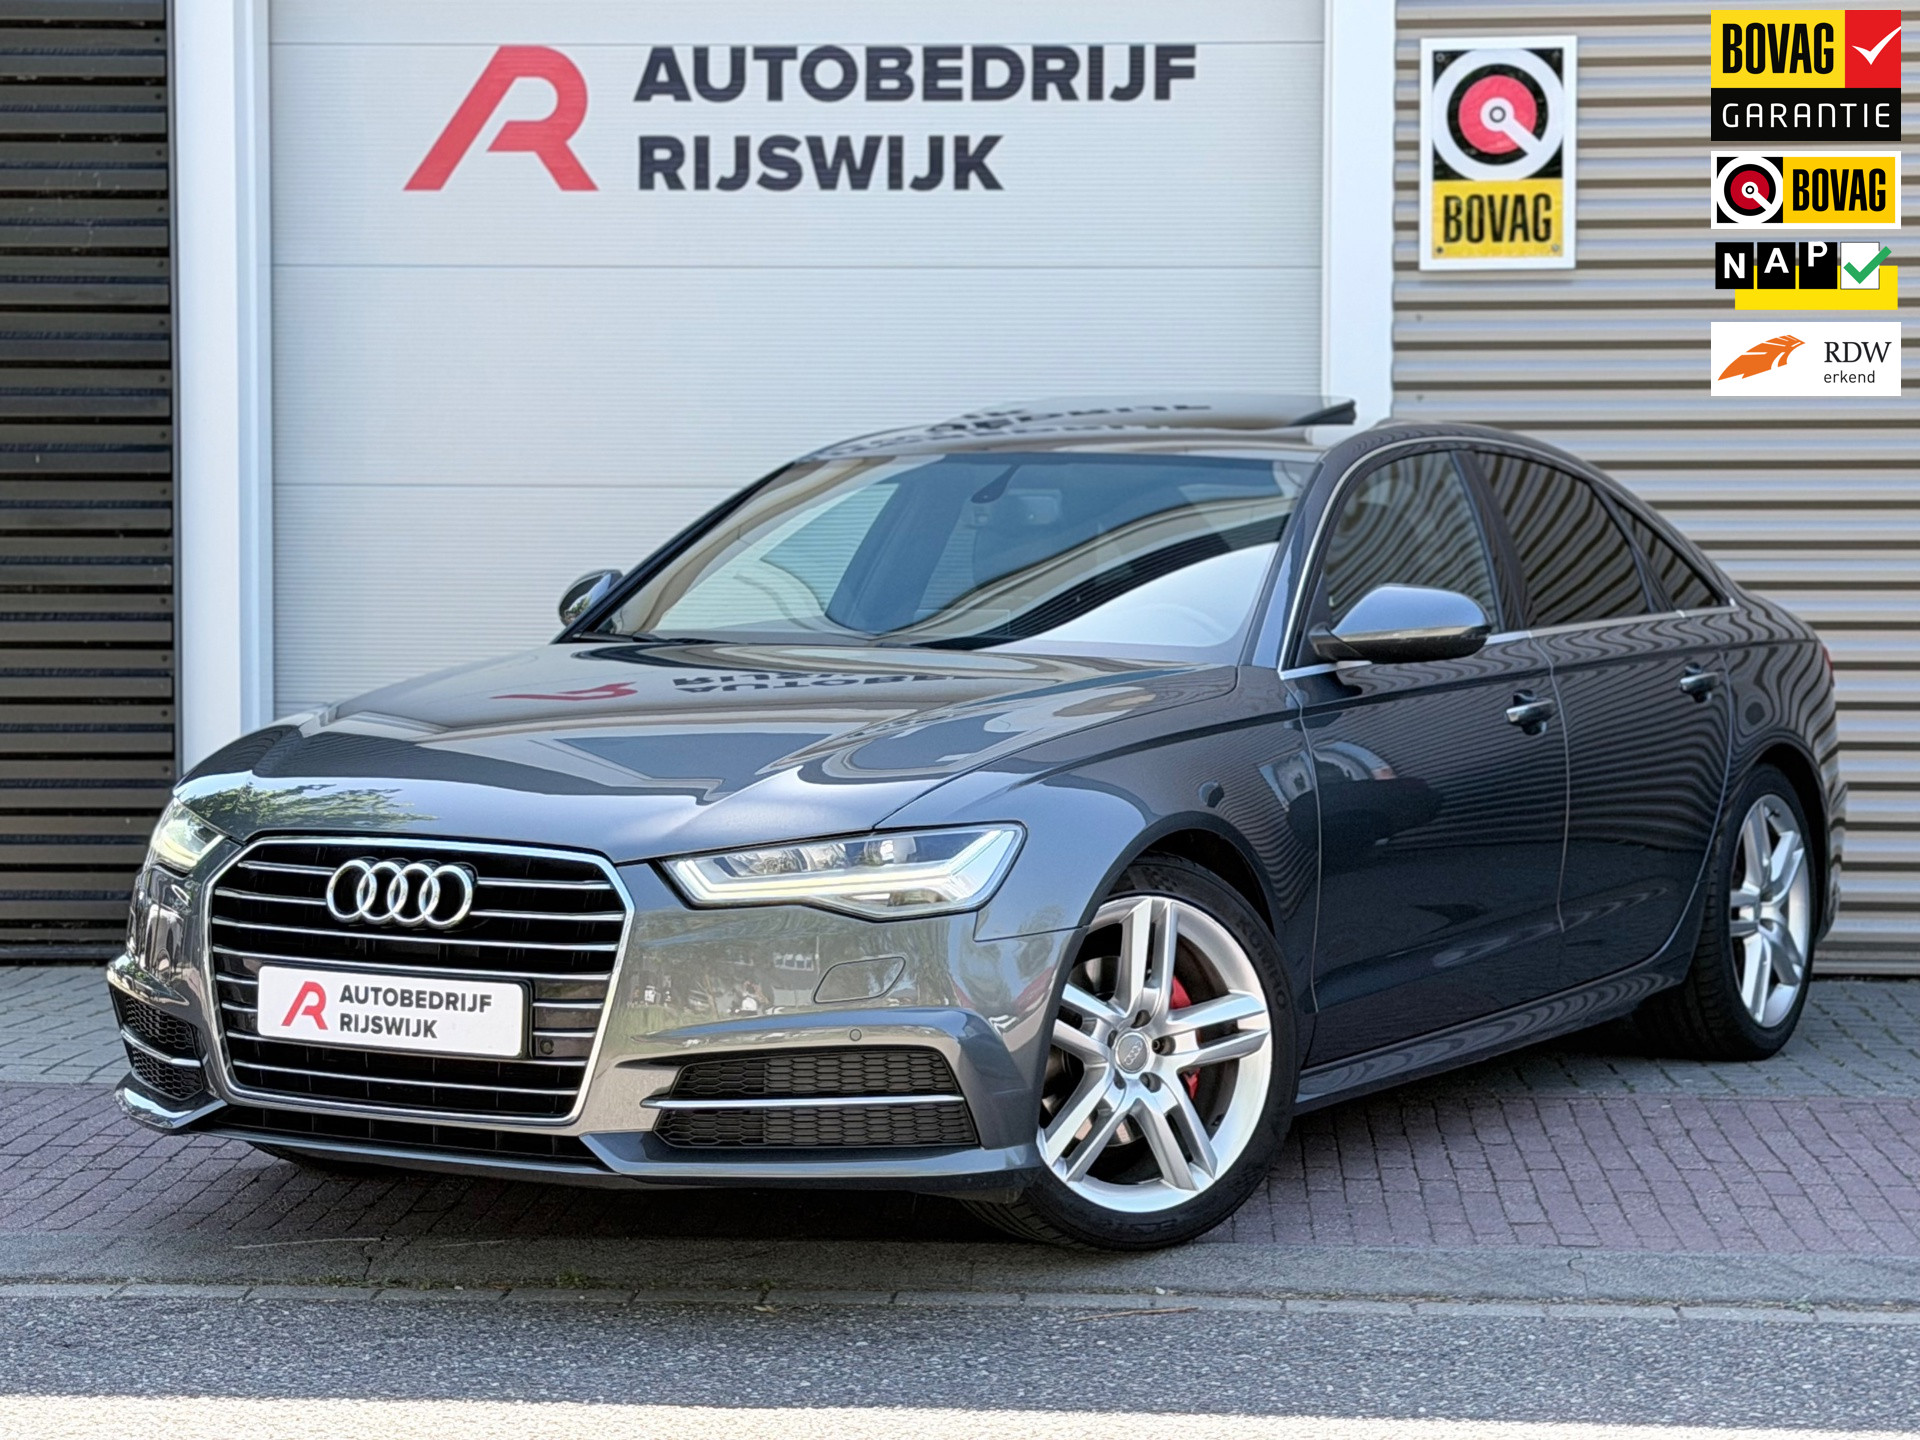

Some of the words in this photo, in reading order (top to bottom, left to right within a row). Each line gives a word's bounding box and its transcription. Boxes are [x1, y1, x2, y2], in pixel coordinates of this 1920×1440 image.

[634, 44, 1197, 103] AUTOBEDRIJF
[638, 135, 1004, 192] RIJSWIJK
[1443, 193, 1553, 244] BOVAG
[339, 984, 493, 1013] AUTOBEDRIJF
[339, 1013, 438, 1039] RIJSWIJK
